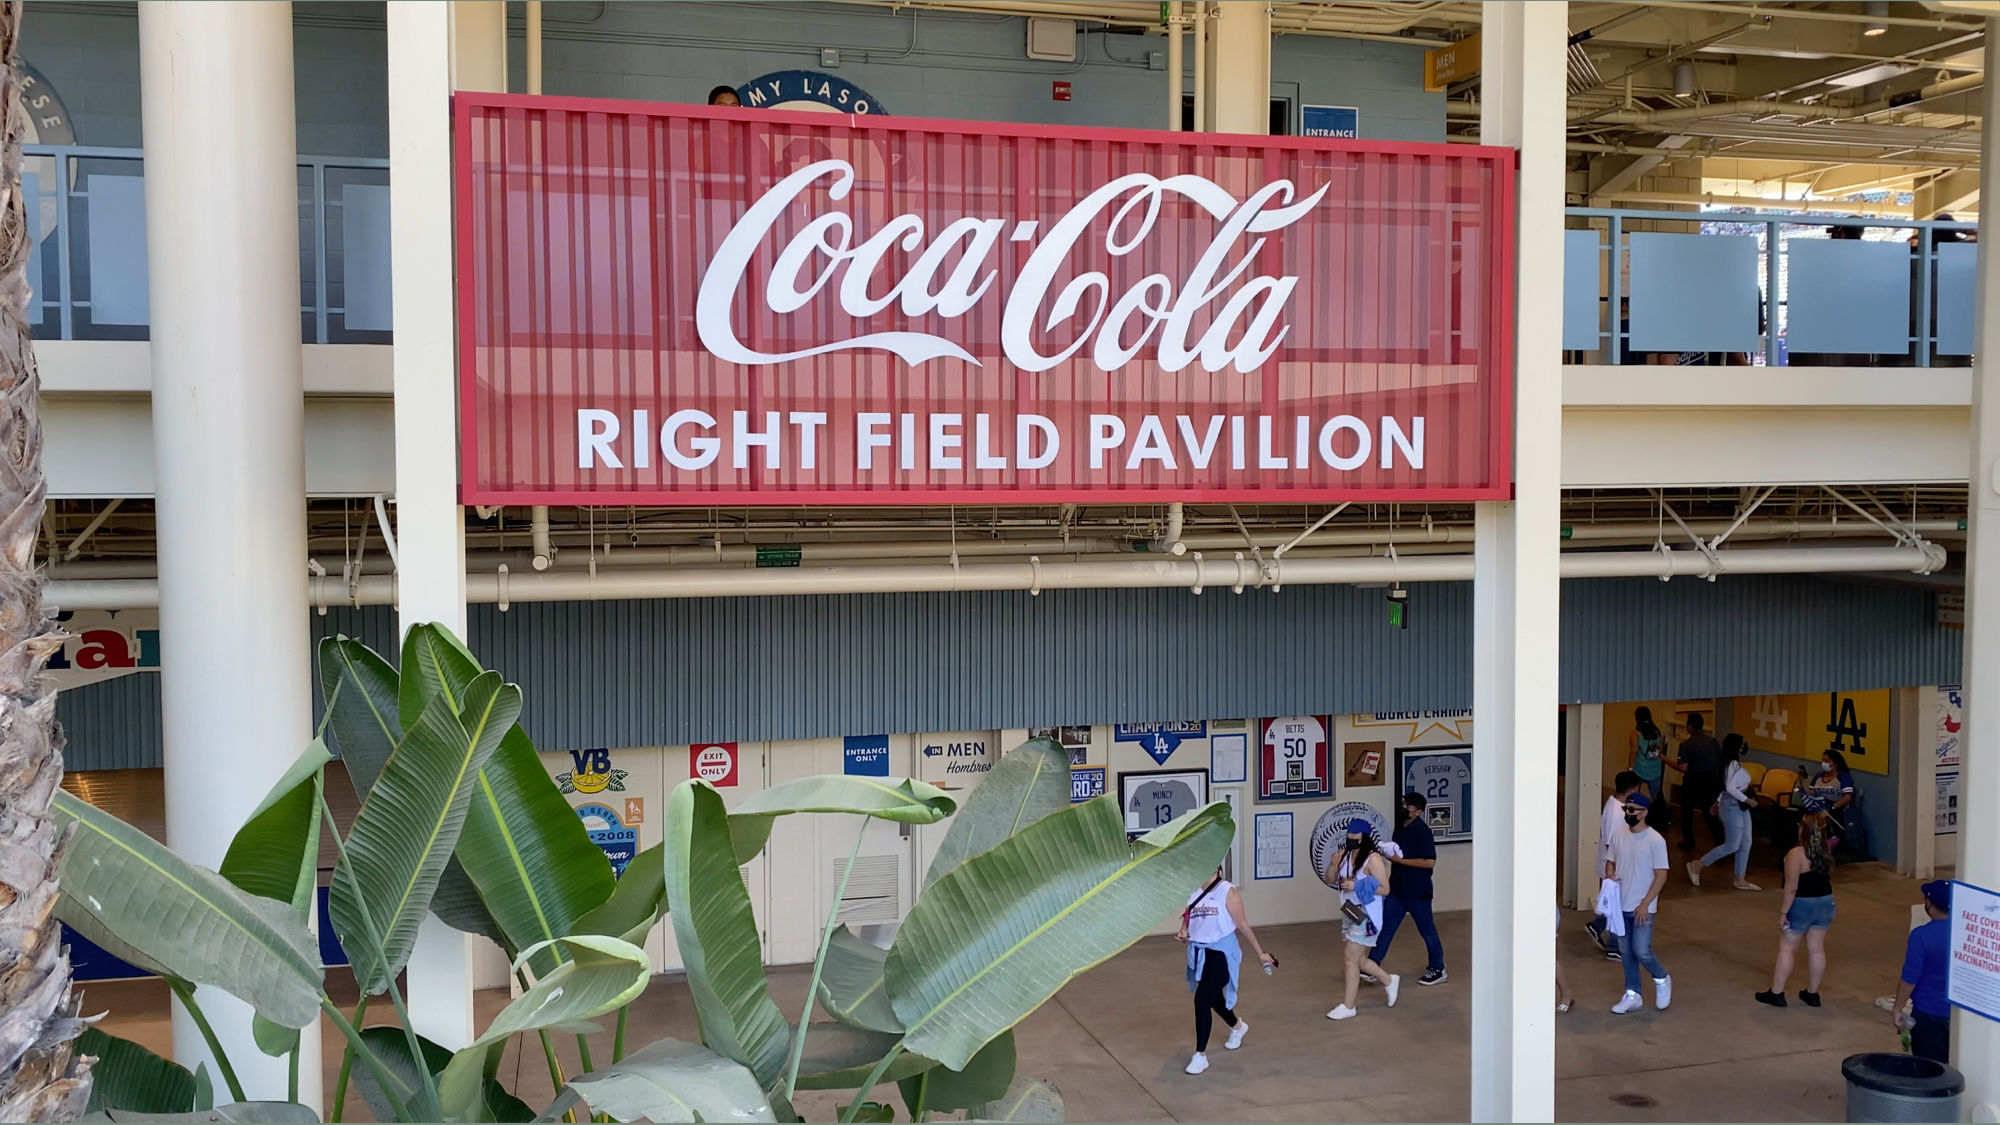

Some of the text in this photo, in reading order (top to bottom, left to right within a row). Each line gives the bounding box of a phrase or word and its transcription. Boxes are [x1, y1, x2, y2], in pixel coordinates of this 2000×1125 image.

[1436, 50, 1455, 71] MEN
[19, 75, 61, 128] ESE
[748, 78, 869, 114] MY LASO
[1306, 128, 1354, 138] ENTRANCE
[696, 159, 1331, 374] Coca-Cola
[578, 408, 1424, 471] RIGHT FIELD PAVILION
[1285, 725, 1305, 733] BETTS
[1826, 691, 1867, 756] LA
[846, 747, 887, 756] ENTRANCE
[931, 742, 985, 757] IN MEN
[1154, 733, 1168, 754] LA
[1284, 738, 1306, 758] 50
[569, 748, 611, 775] VB
[704, 752, 723, 760] EXIT
[855, 754, 878, 762] ONLY
[946, 760, 992, 774] Hombres
[1153, 790, 1173, 800] MUNCY
[1427, 777, 1449, 798] 22
[1155, 804, 1172, 825] 13
[597, 831, 634, 841] 2008
[1962, 910, 2000, 930] FACE COVE
[1965, 922, 2000, 941] ARE REQU
[1967, 934, 1976, 943] AT
[1977, 937, 1988, 949] ALL
[1963, 943, 2000, 963] REGARDLE
